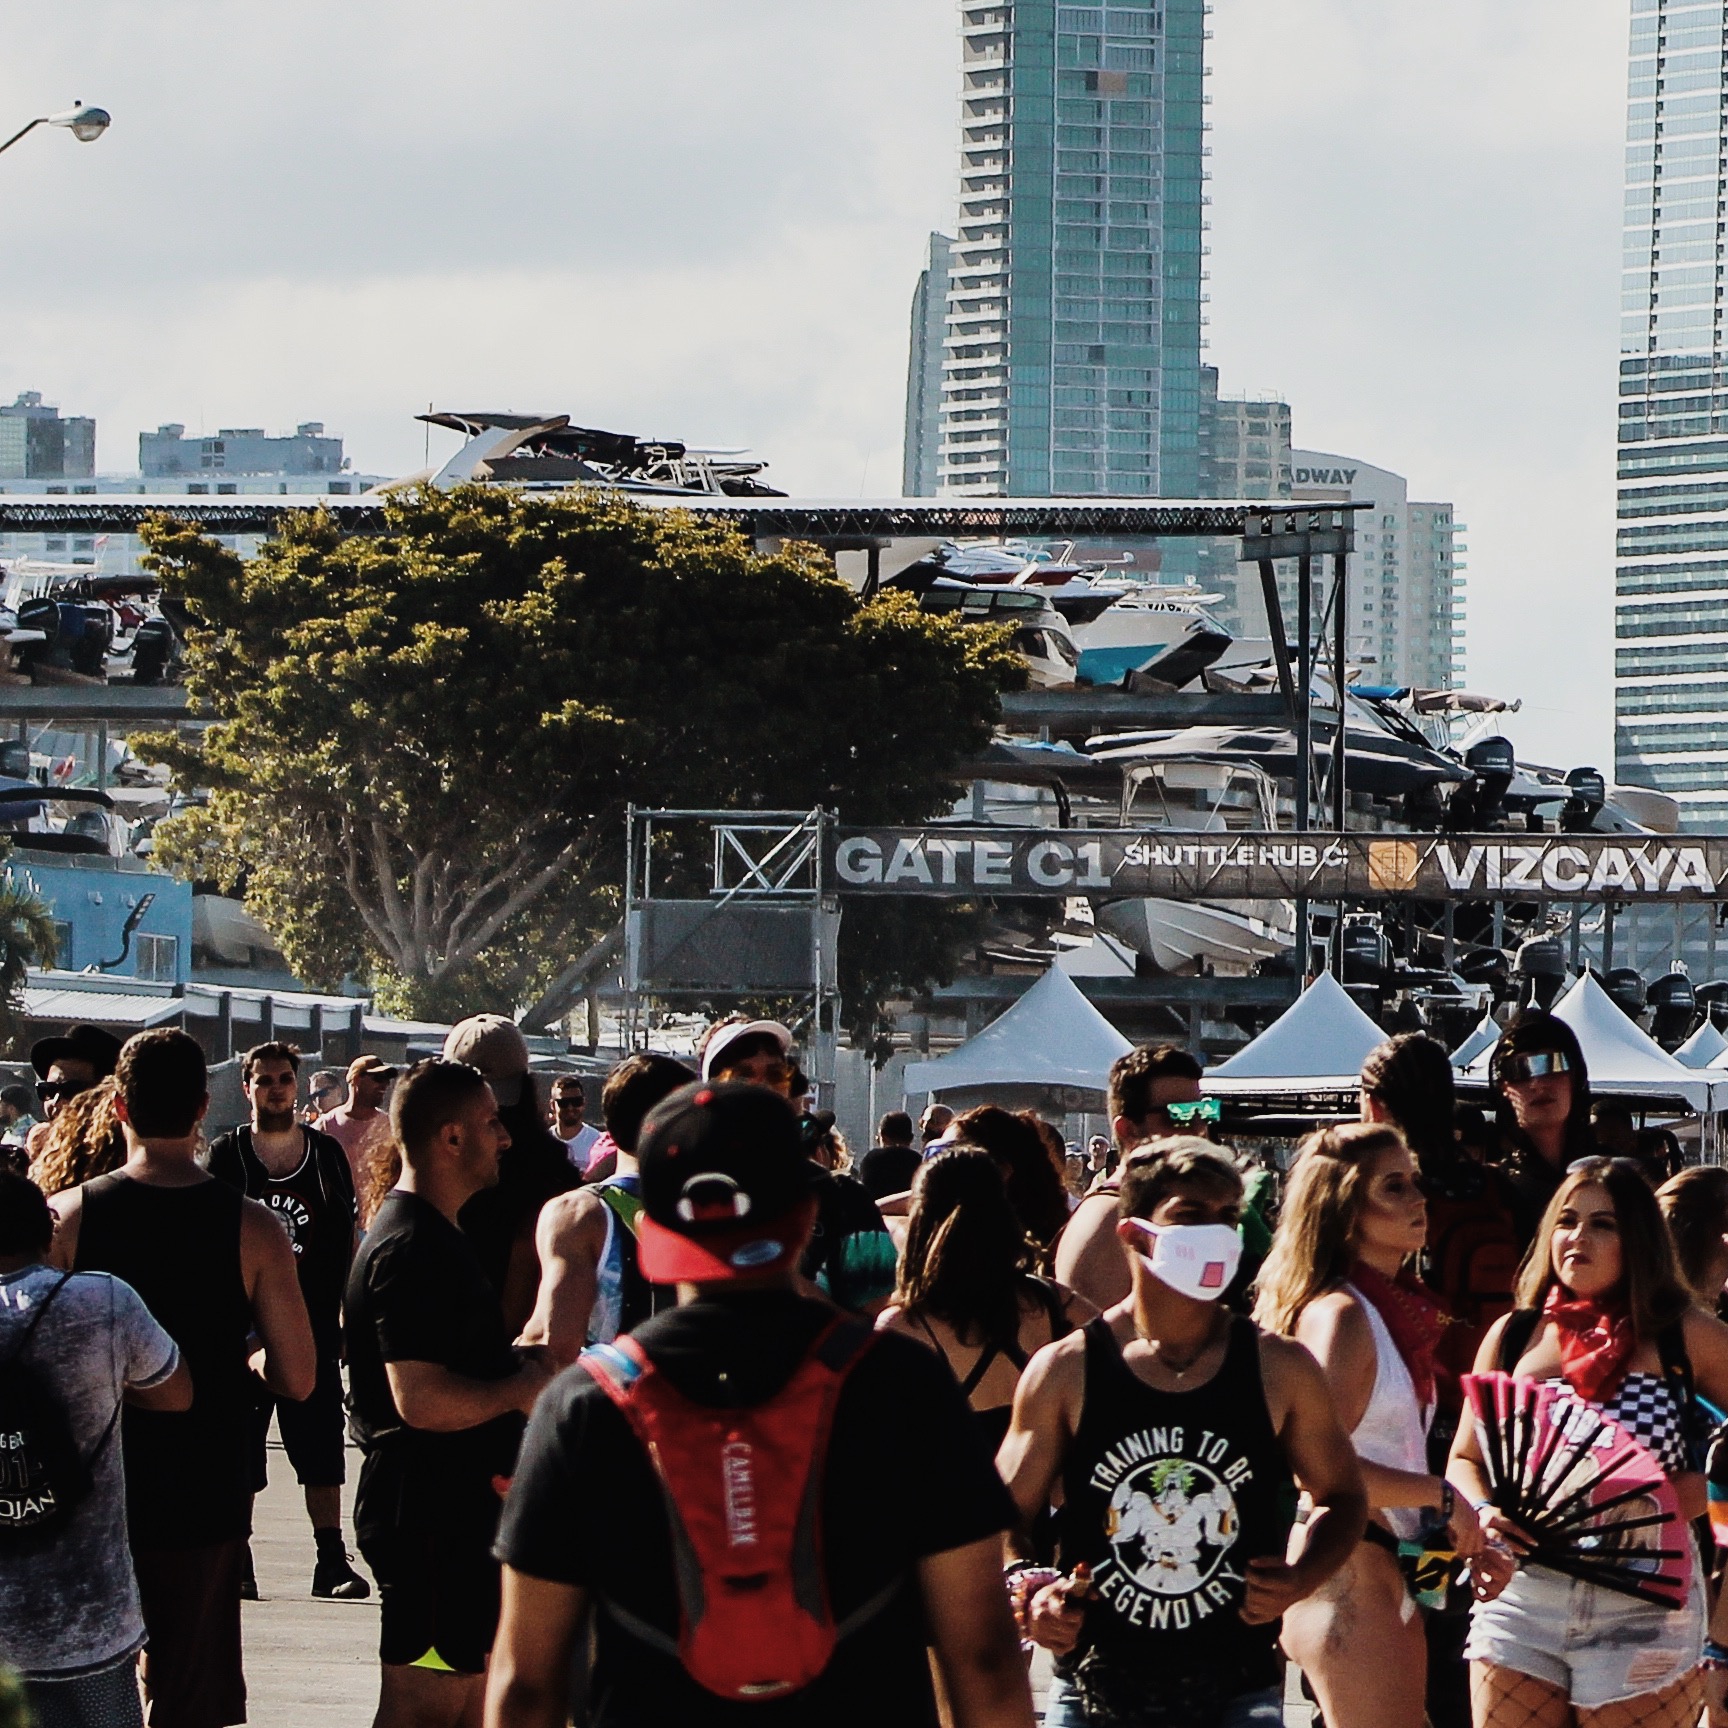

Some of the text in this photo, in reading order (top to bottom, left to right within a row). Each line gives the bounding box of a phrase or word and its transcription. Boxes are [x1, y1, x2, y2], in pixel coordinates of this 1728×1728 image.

[1290, 468, 1357, 485] DWAY
[835, 836, 1112, 888] GATE C1
[1124, 845, 1255, 867] SHUTTLE
[1258, 845, 1318, 867] HUB
[1435, 845, 1717, 893] VIZCAYA
[1089, 1426, 1253, 1493] TRAINING TO BE
[1091, 1557, 1247, 1630] LEGENDARY
